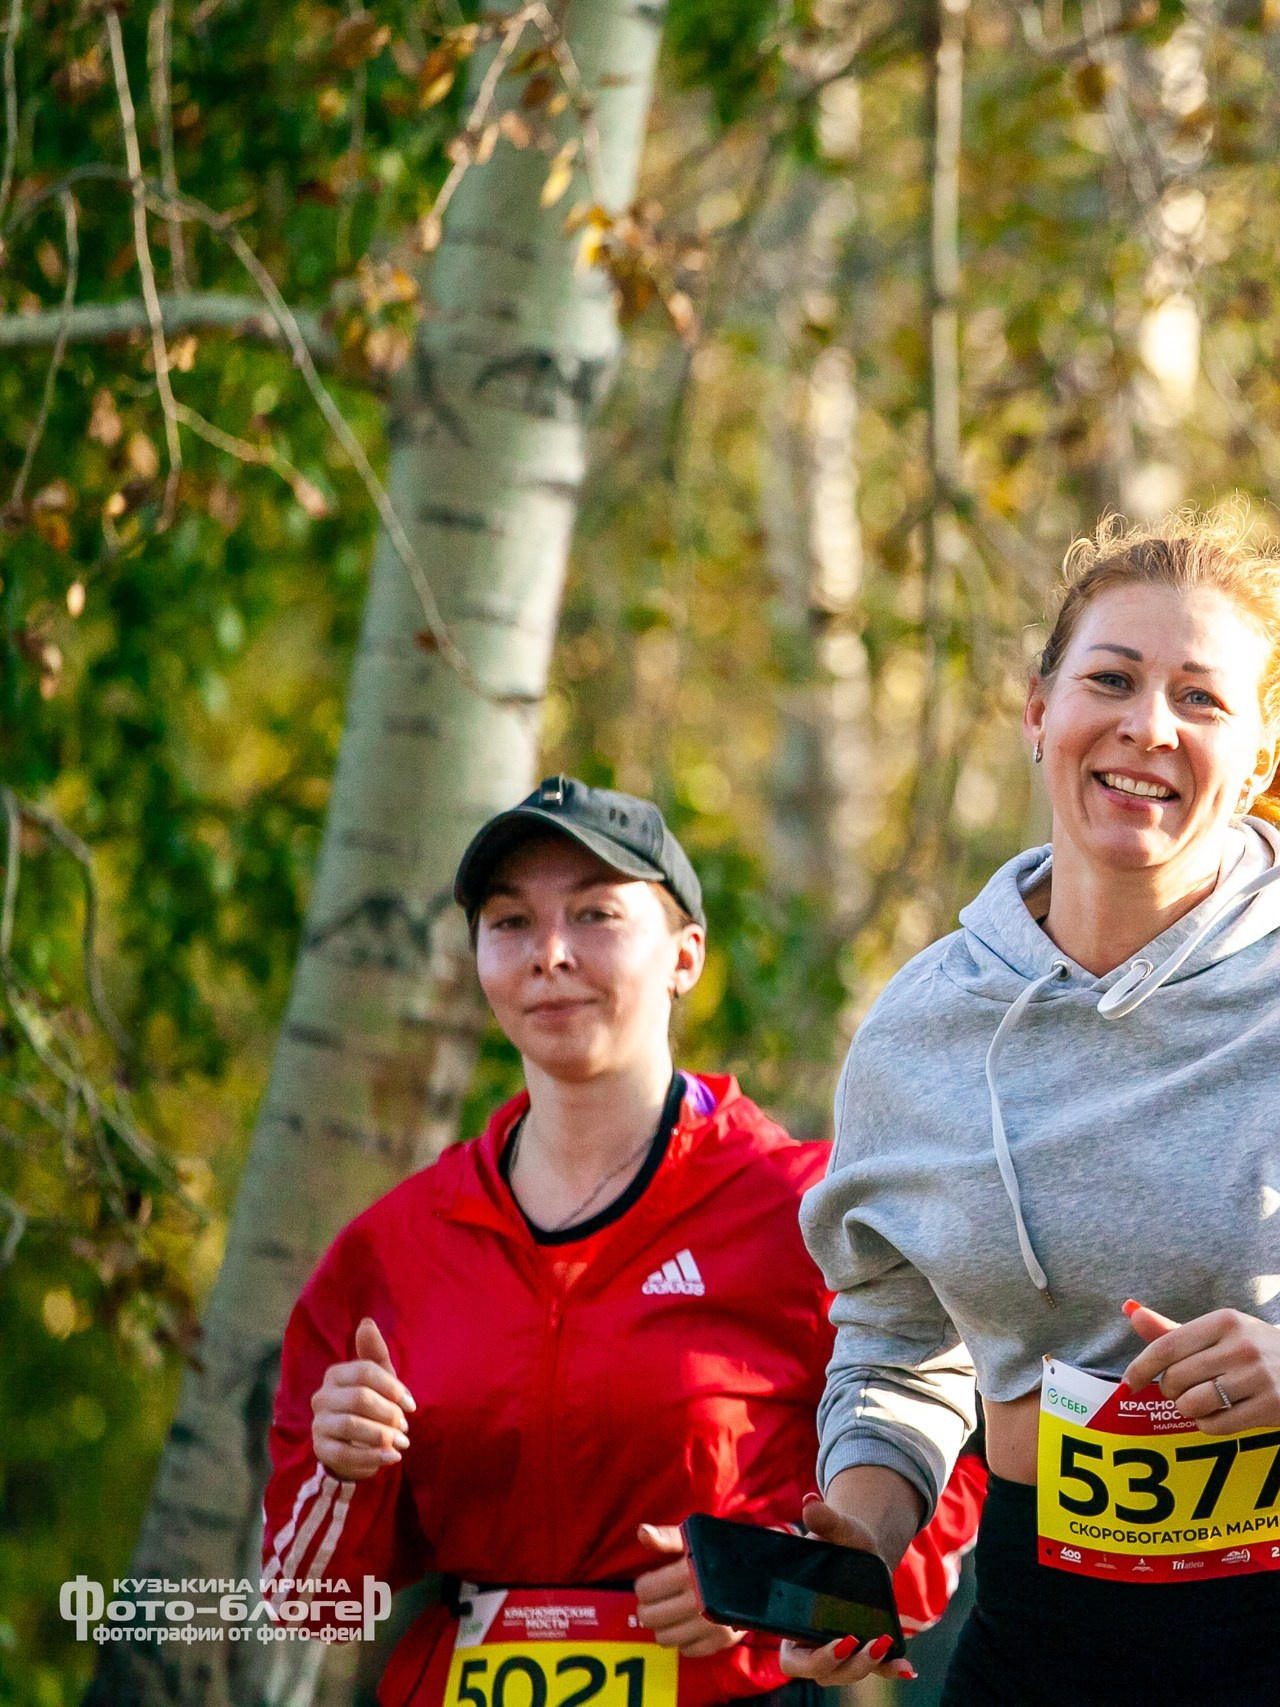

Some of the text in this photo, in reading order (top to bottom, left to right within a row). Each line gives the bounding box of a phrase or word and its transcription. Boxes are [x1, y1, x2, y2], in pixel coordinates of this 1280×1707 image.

[1060, 1396, 1088, 1415] СБЕР
[1119, 1400, 1178, 1411] КРАСНО
[1150, 1410, 1187, 1422] МОС
[1069, 1521, 1223, 1544] СКОРОБОГАТОВА
[1060, 1547, 1081, 1560] 400
[457, 1655, 646, 1707] 5021
